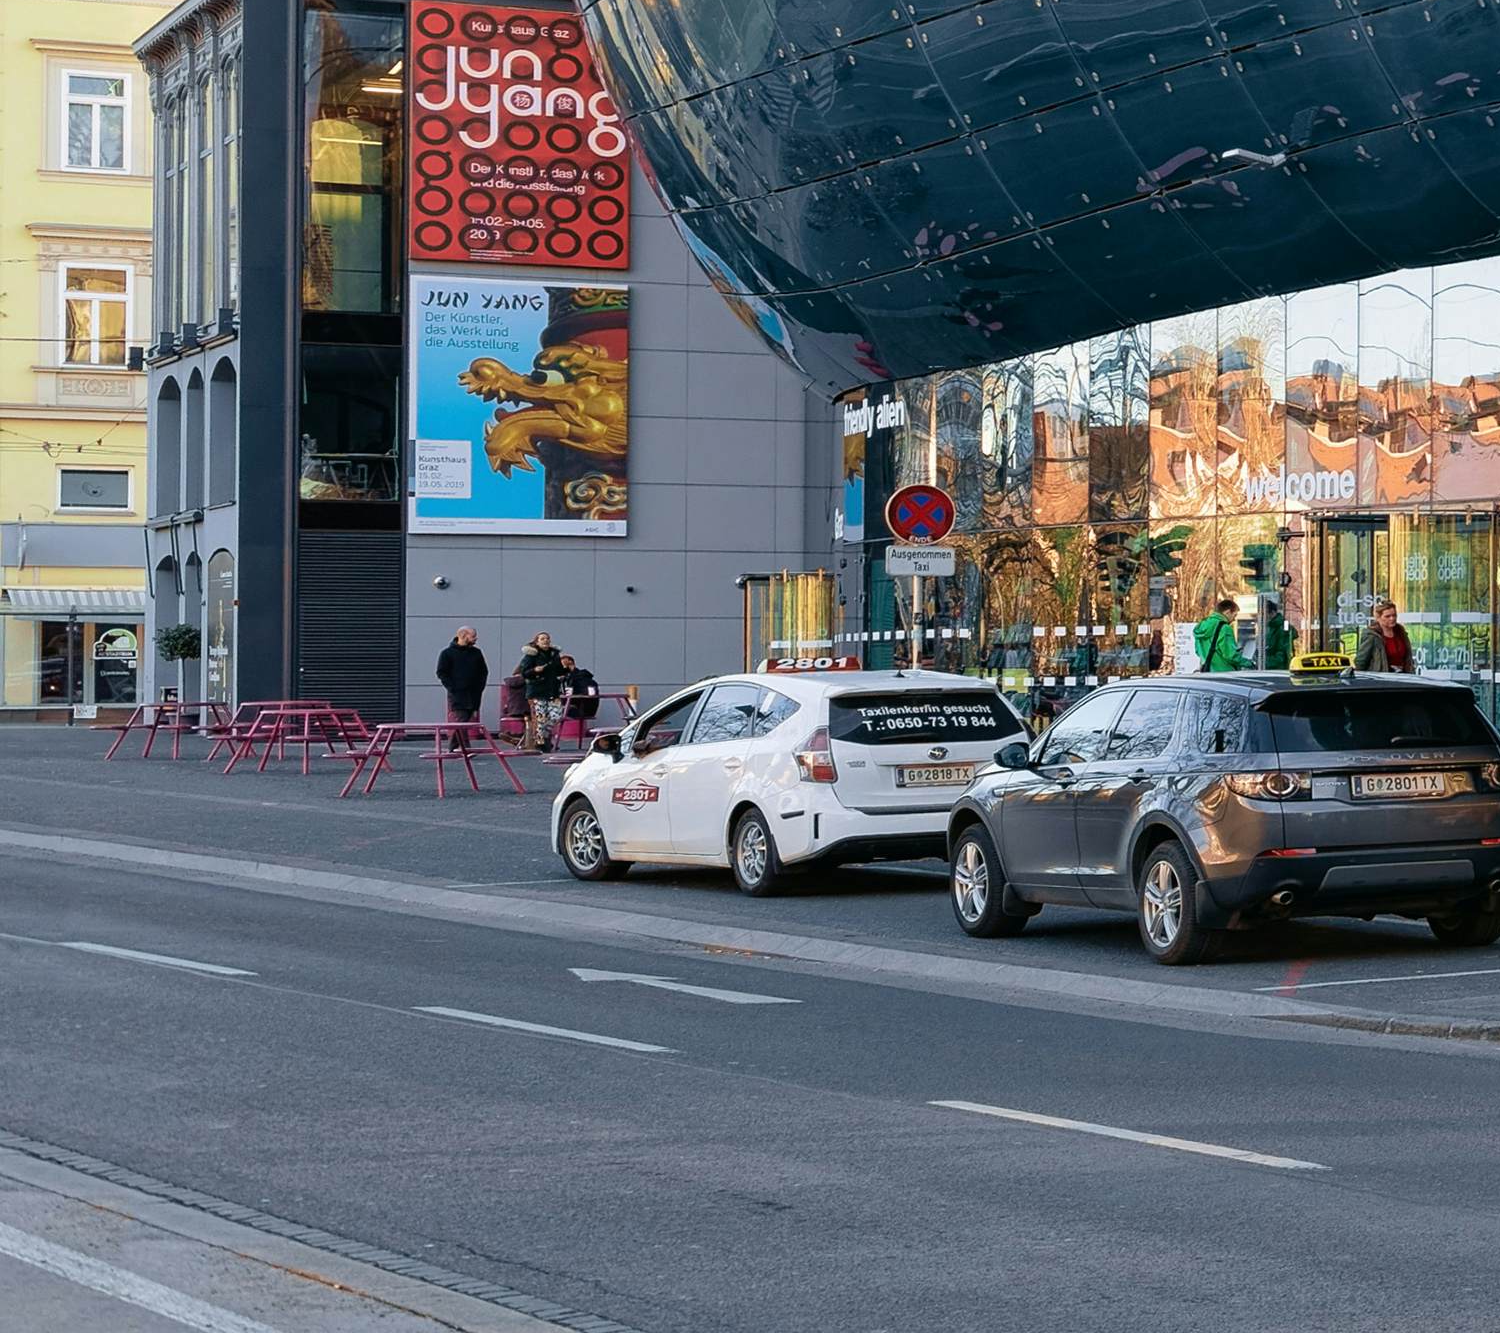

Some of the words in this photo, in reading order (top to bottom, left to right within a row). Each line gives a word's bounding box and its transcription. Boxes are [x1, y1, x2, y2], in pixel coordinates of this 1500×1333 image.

[540, 26, 570, 39] Gaz
[496, 164, 547, 178] Knstlr,
[421, 291, 469, 309] JUN
[481, 293, 544, 311] YANG
[425, 311, 446, 323] Der
[451, 312, 503, 325] Künstler,
[425, 324, 446, 335] das
[451, 326, 482, 336] Werk
[486, 326, 509, 337] und
[425, 337, 443, 348] die
[447, 337, 519, 352] Ausstellung
[876, 393, 906, 430] alien
[419, 455, 467, 464] Kunsthaus
[1246, 465, 1356, 502] welcome
[908, 534, 933, 544] ENDE
[891, 549, 952, 562] Ausgenommen
[913, 562, 930, 573] Taxi
[776, 657, 848, 669] 2801
[1311, 657, 1342, 667] TAXI
[858, 704, 940, 718] Taxilenker/in
[943, 704, 991, 716] gesucht
[951, 717, 968, 728] 19
[971, 716, 996, 728] 844
[908, 768, 916, 781] G
[925, 767, 953, 781] 2818
[954, 766, 970, 779] TX
[1367, 778, 1375, 792] G
[1386, 776, 1419, 791] 2801
[1420, 775, 1438, 787] TX
[623, 789, 649, 800] 2801
